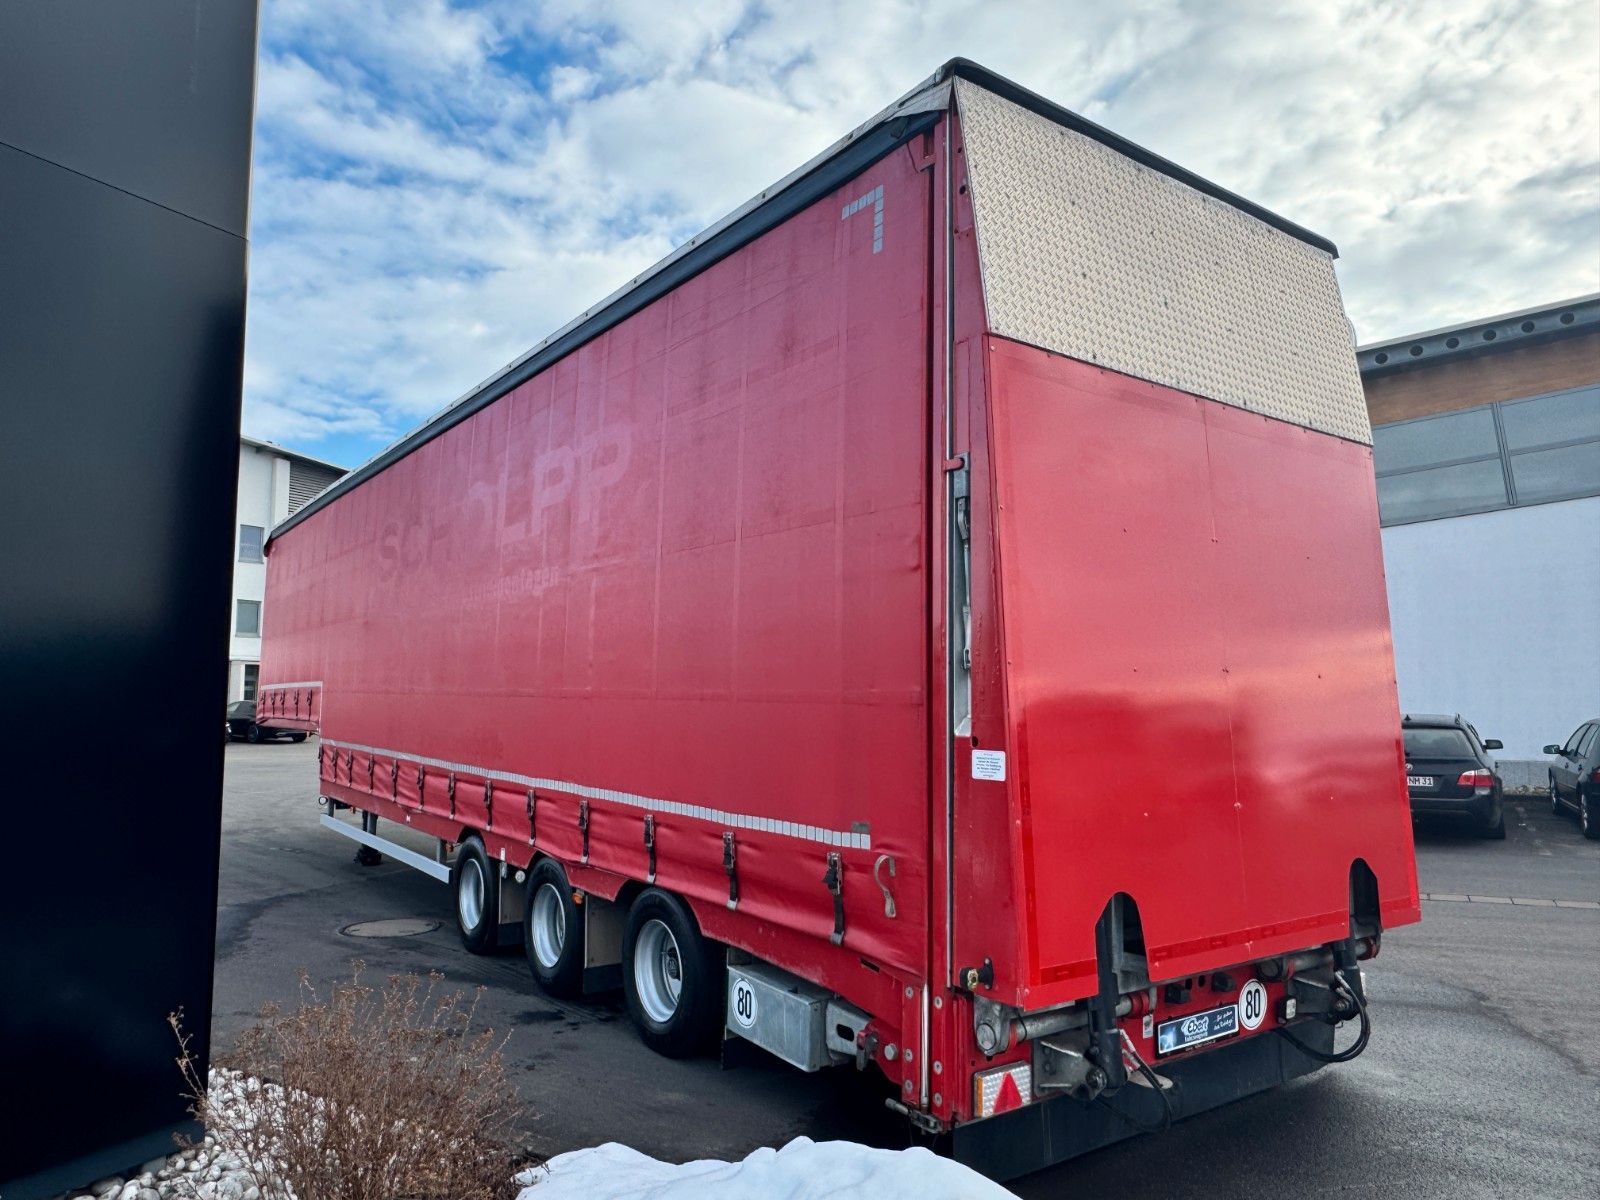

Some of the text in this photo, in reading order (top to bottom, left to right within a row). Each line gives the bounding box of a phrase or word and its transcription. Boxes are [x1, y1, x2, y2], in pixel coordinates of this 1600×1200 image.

[1422, 777, 1432, 786] 31
[738, 987, 752, 1019] 80
[1246, 988, 1260, 1020] 80
